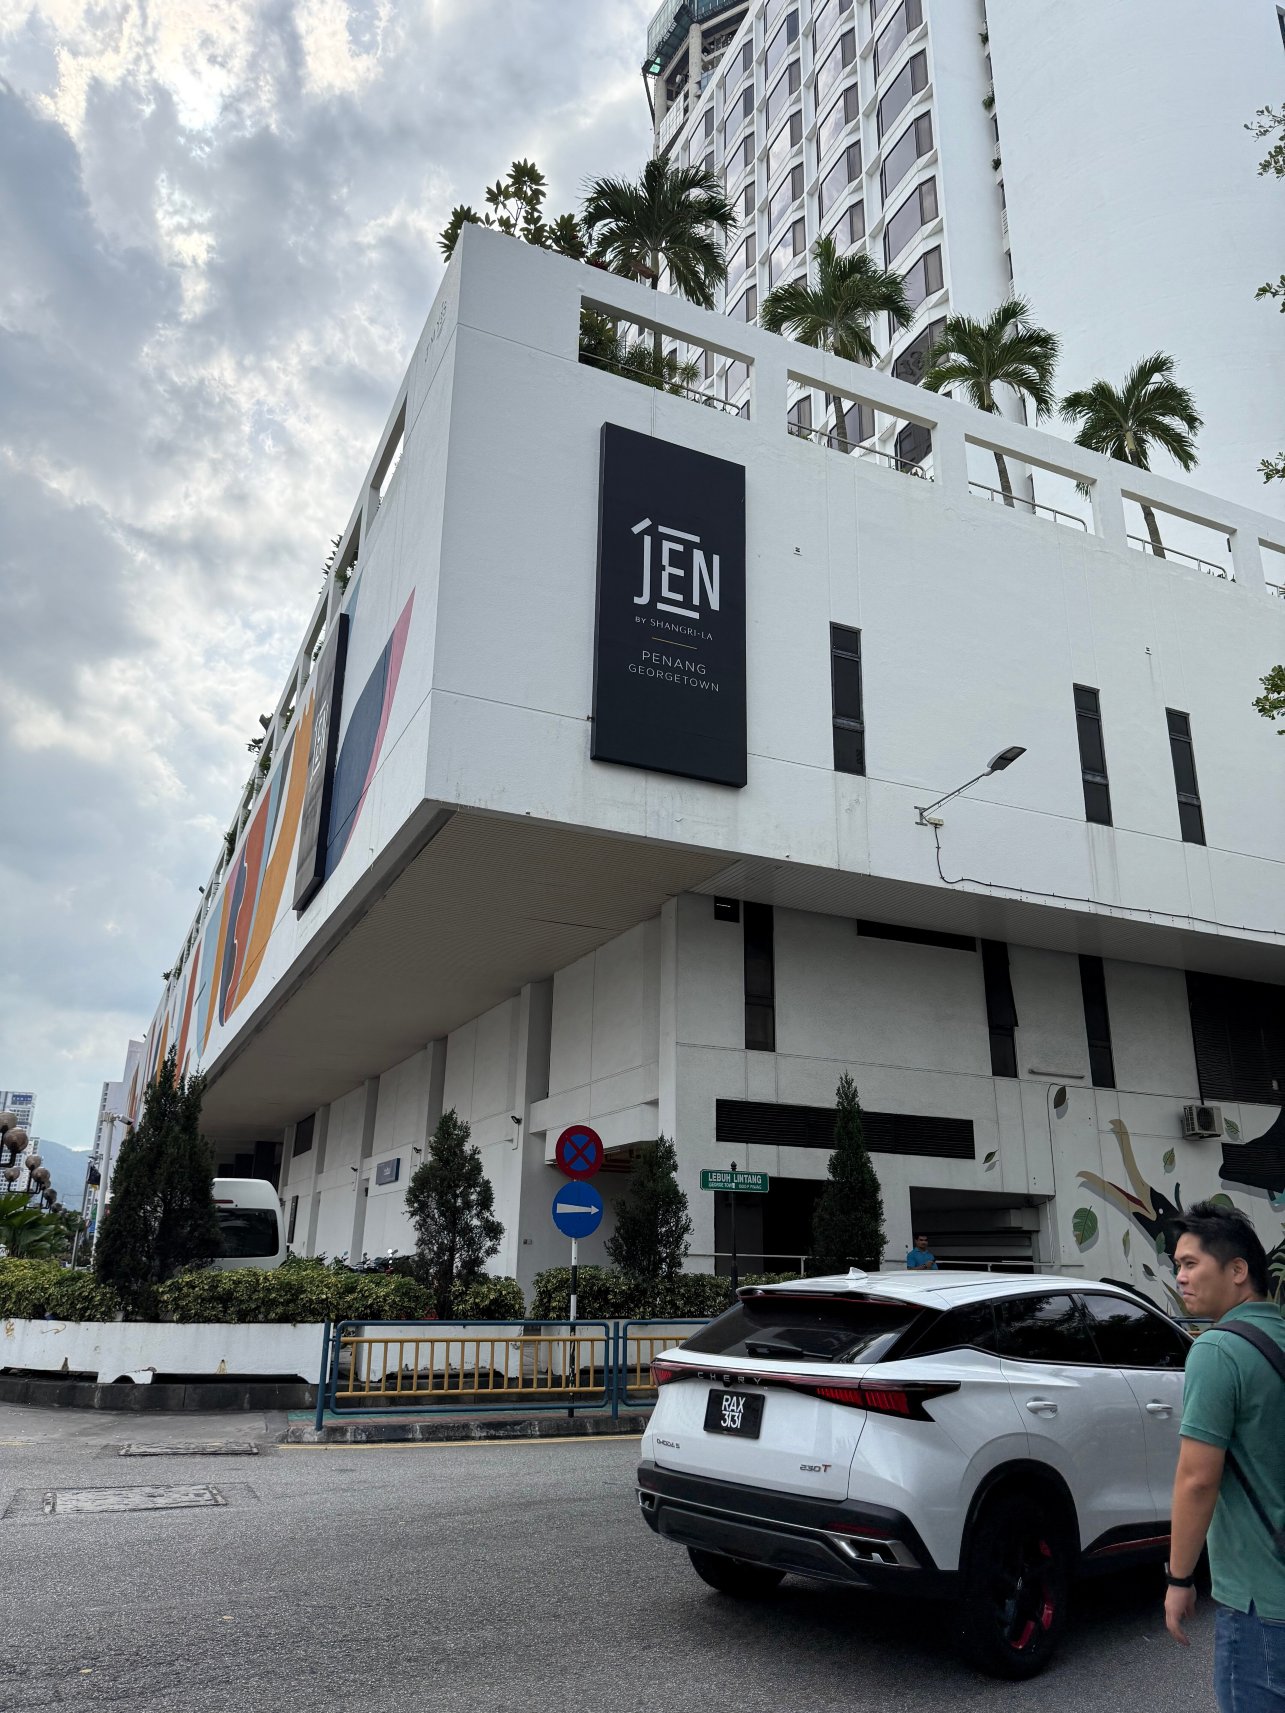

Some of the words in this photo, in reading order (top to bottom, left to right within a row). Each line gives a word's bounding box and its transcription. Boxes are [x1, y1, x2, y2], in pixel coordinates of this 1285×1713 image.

[633, 533, 720, 611] JEN
[635, 616, 647, 624] BY
[642, 650, 707, 675] PENANG
[628, 663, 719, 692] GEORGETOWN
[708, 1172, 731, 1182] LEBUH
[733, 1173, 762, 1184] LINTANG
[697, 1371, 761, 1384] CHERY
[721, 1394, 746, 1413] RAX
[720, 1410, 742, 1429] 3131
